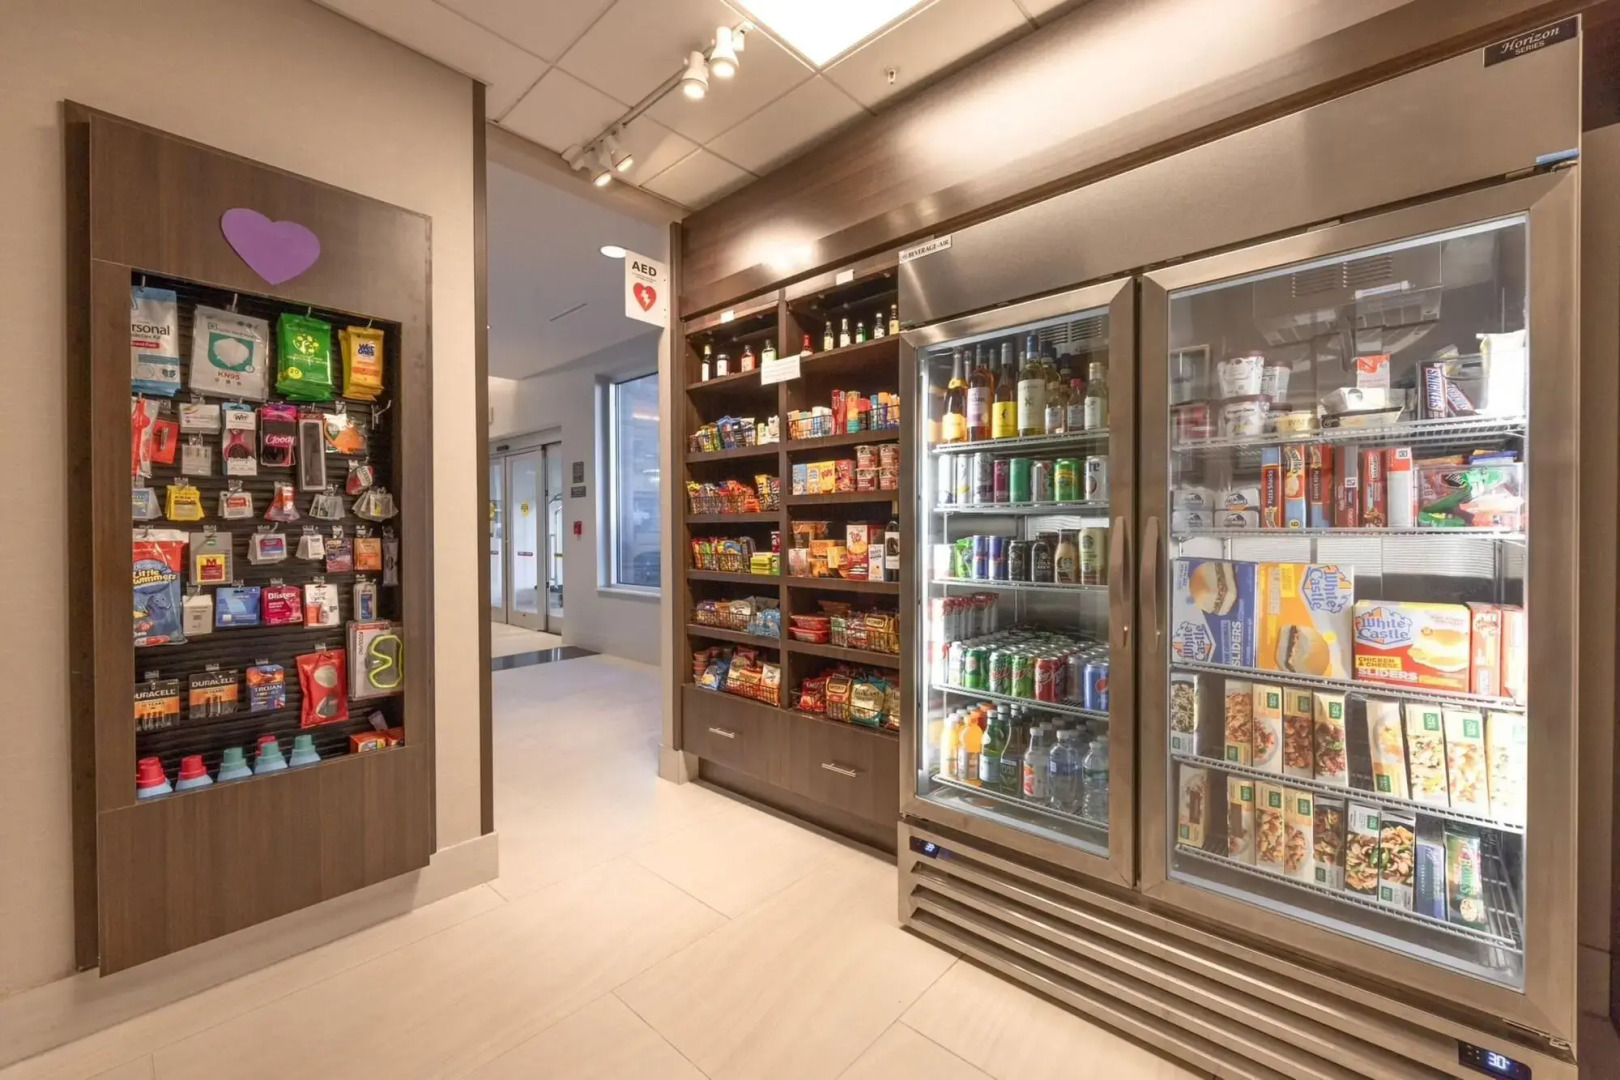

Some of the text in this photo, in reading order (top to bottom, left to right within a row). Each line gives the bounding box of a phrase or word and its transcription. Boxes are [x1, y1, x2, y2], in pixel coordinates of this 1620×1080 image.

[1501, 26, 1560, 54] Horizon
[1515, 41, 1545, 55] SERIES
[631, 260, 657, 277] AED
[131, 323, 170, 336] rsonal
[218, 371, 240, 380] KN95
[1427, 369, 1442, 408] SNICKERS
[132, 573, 176, 585] wimmers
[268, 591, 296, 600] Blistex
[1310, 568, 1325, 610] Castle
[1324, 572, 1338, 608] White
[1362, 618, 1406, 630] White
[1358, 628, 1409, 639] Castle
[1182, 627, 1195, 660] White
[1193, 625, 1206, 662] Castle
[1231, 621, 1242, 666] SLIDERS
[191, 677, 235, 688] DURACELL
[254, 684, 283, 693] TROJAN
[134, 688, 176, 700] URACELL
